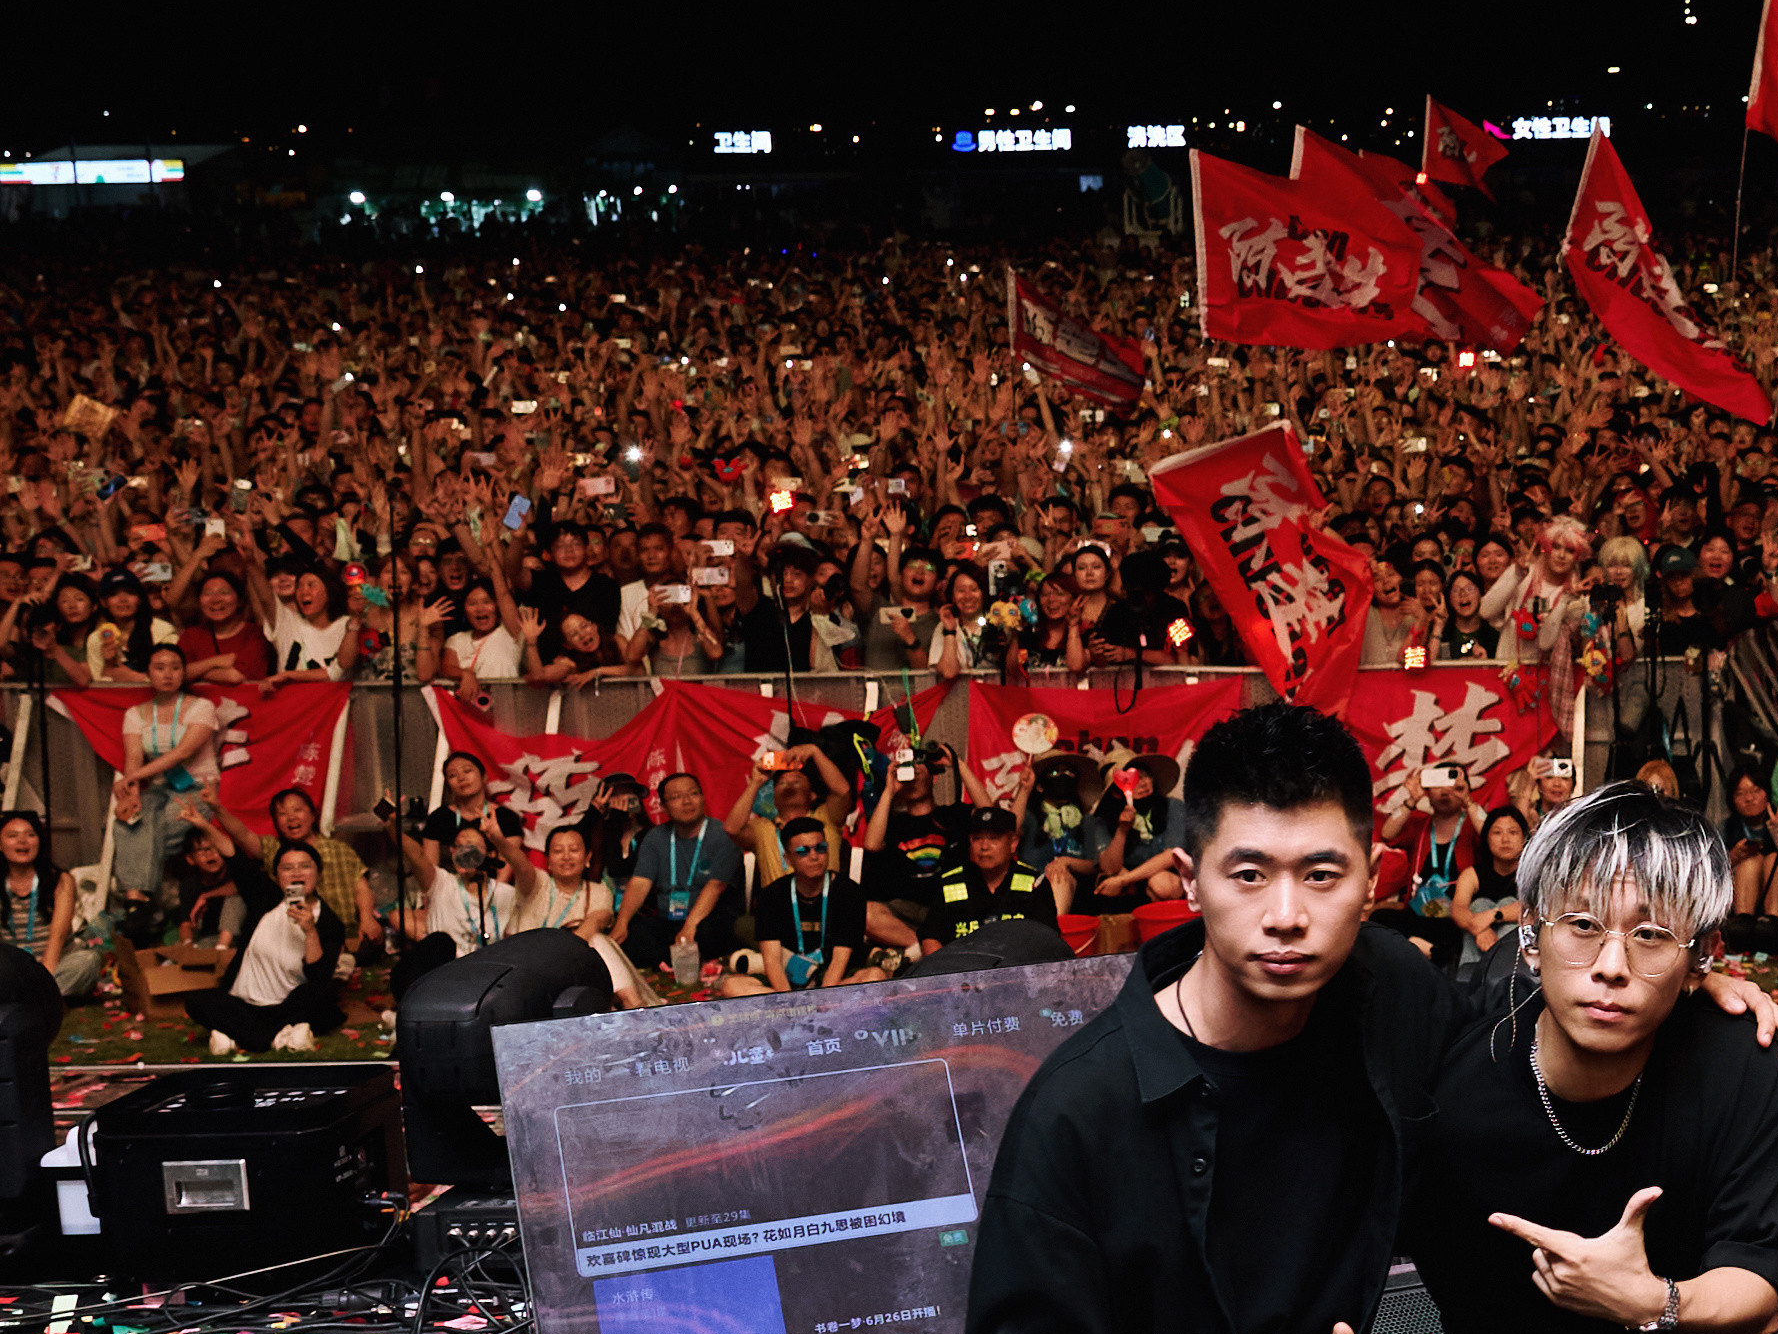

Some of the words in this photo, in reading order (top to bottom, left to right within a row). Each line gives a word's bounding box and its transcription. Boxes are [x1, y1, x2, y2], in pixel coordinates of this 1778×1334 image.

[978, 128, 1072, 152] 男性卫生间
[1127, 125, 1186, 148] 清洗区
[1511, 116, 1610, 140] 女性卫生间
[714, 131, 772, 154] 卫生间
[952, 1016, 1021, 1038] 单片付费
[1050, 1010, 1085, 1028] 免费
[565, 1067, 602, 1087] 我的
[635, 1057, 691, 1079] 看电视
[806, 1038, 842, 1057] 首页
[612, 1287, 655, 1306] 水浒传
